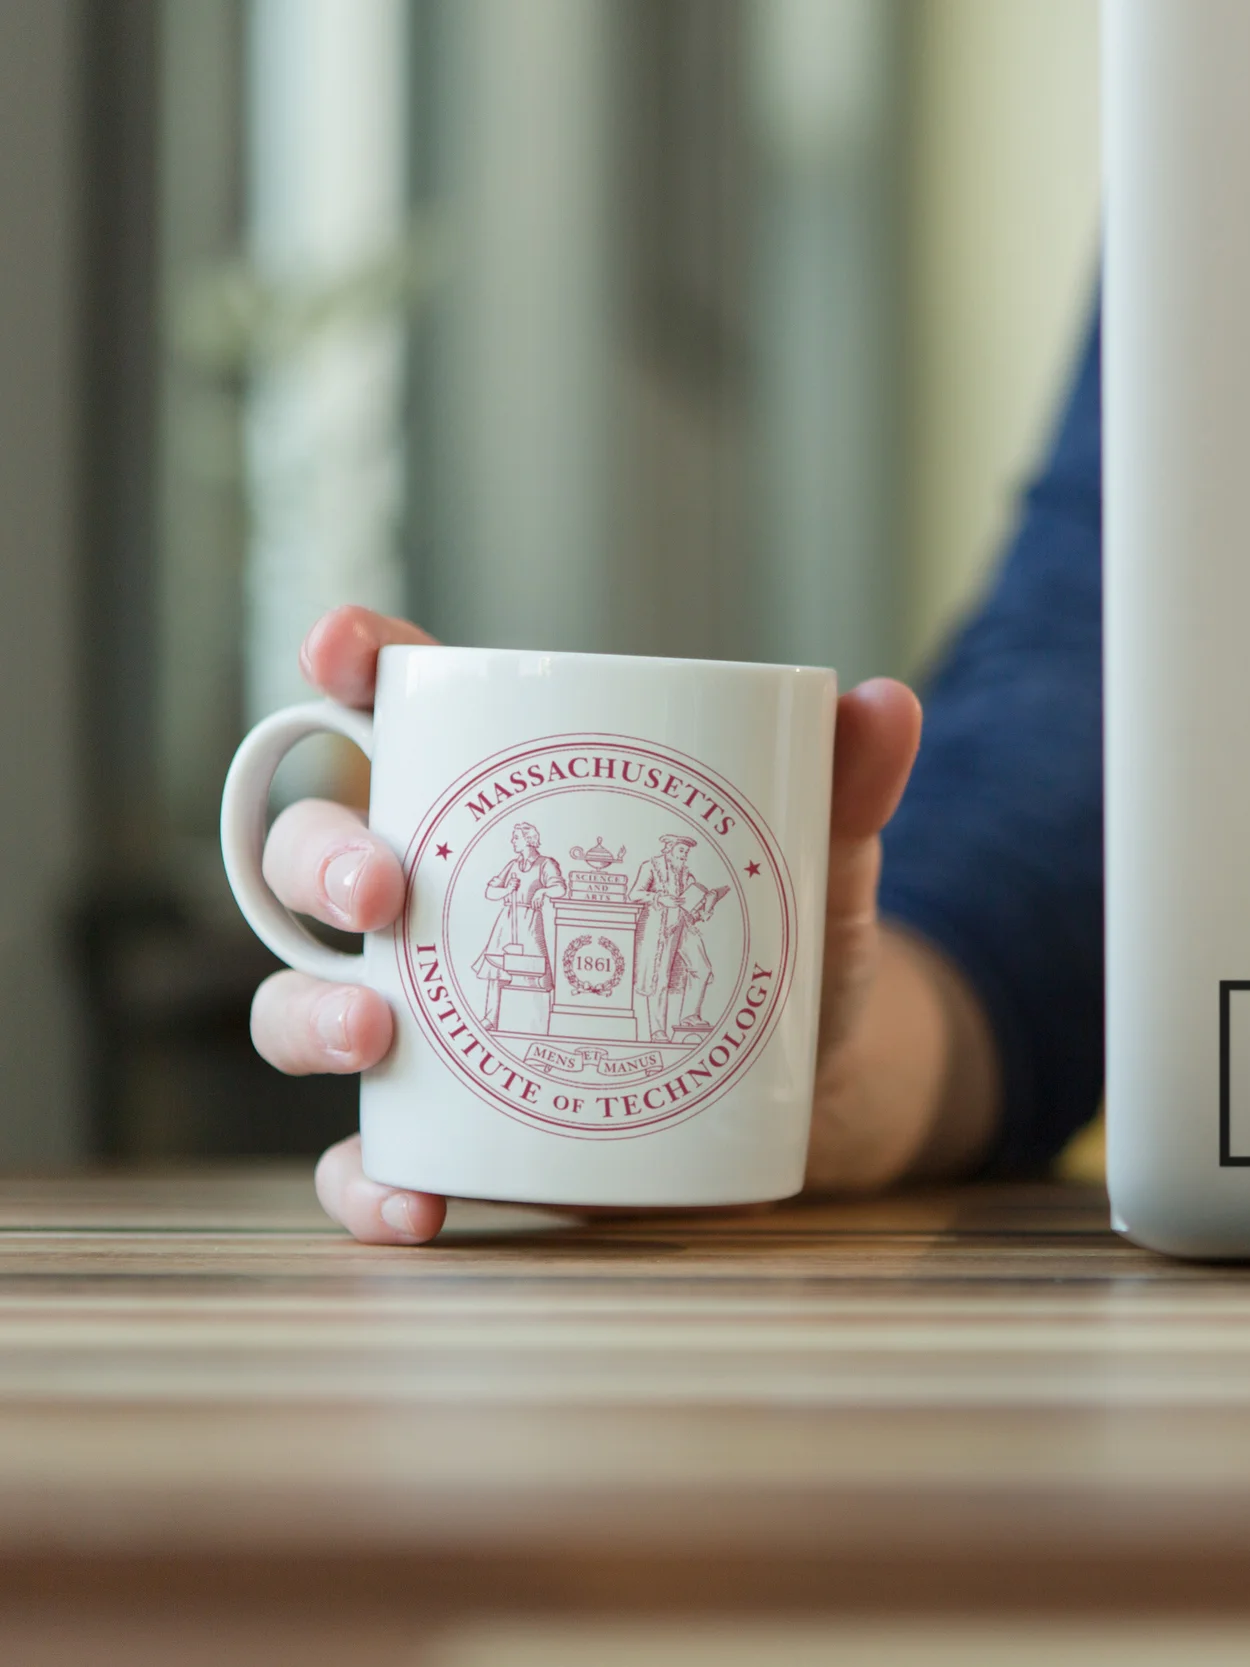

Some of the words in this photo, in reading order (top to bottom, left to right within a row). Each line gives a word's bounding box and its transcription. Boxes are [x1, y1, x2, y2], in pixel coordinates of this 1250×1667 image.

[464, 756, 736, 836] MASSACHUSETTS
[575, 873, 620, 883] SCIENCE
[587, 884, 609, 892] AND
[577, 955, 611, 973] 1861
[416, 943, 541, 1104] INSTITUTE
[552, 1095, 585, 1113] OF
[595, 961, 773, 1118] TECHNOLOGY
[533, 1046, 575, 1069] MENS
[584, 1051, 599, 1061] ET
[604, 1054, 657, 1073] MANUS
